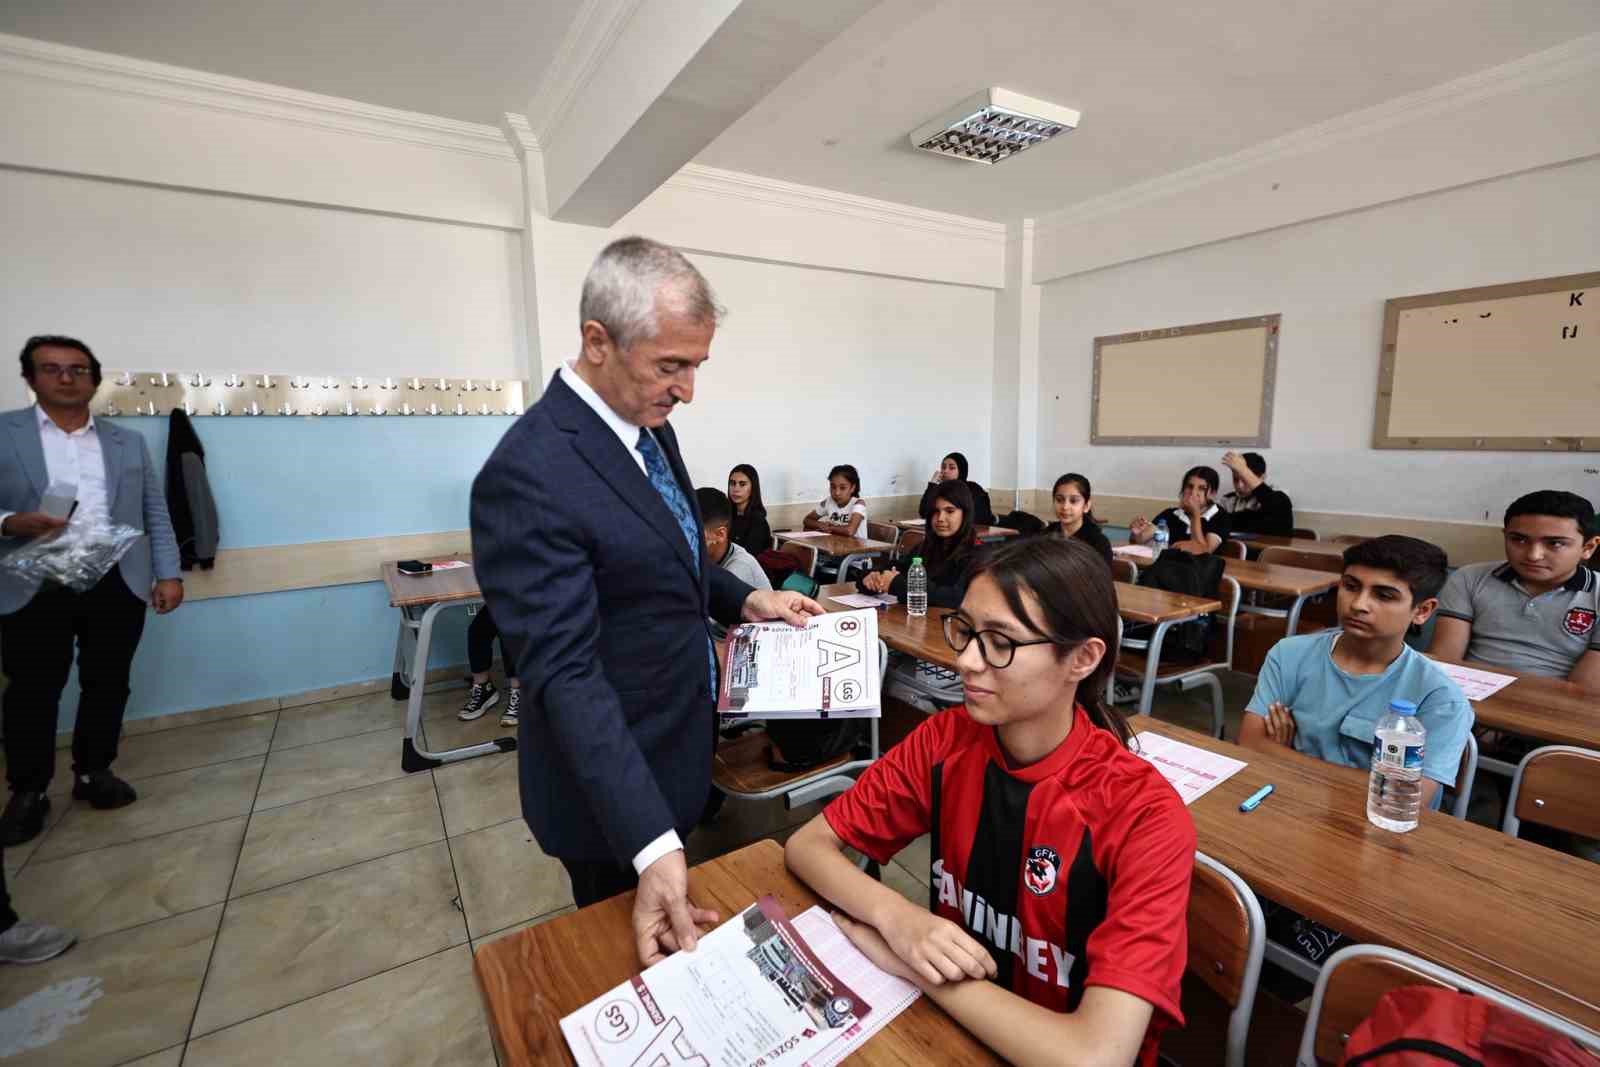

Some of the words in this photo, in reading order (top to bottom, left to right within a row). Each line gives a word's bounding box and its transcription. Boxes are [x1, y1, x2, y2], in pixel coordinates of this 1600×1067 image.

[817, 639, 861, 677] A
[842, 682, 854, 700] LGS
[1035, 848, 1057, 861] GFK
[604, 1004, 630, 1037] LGS
